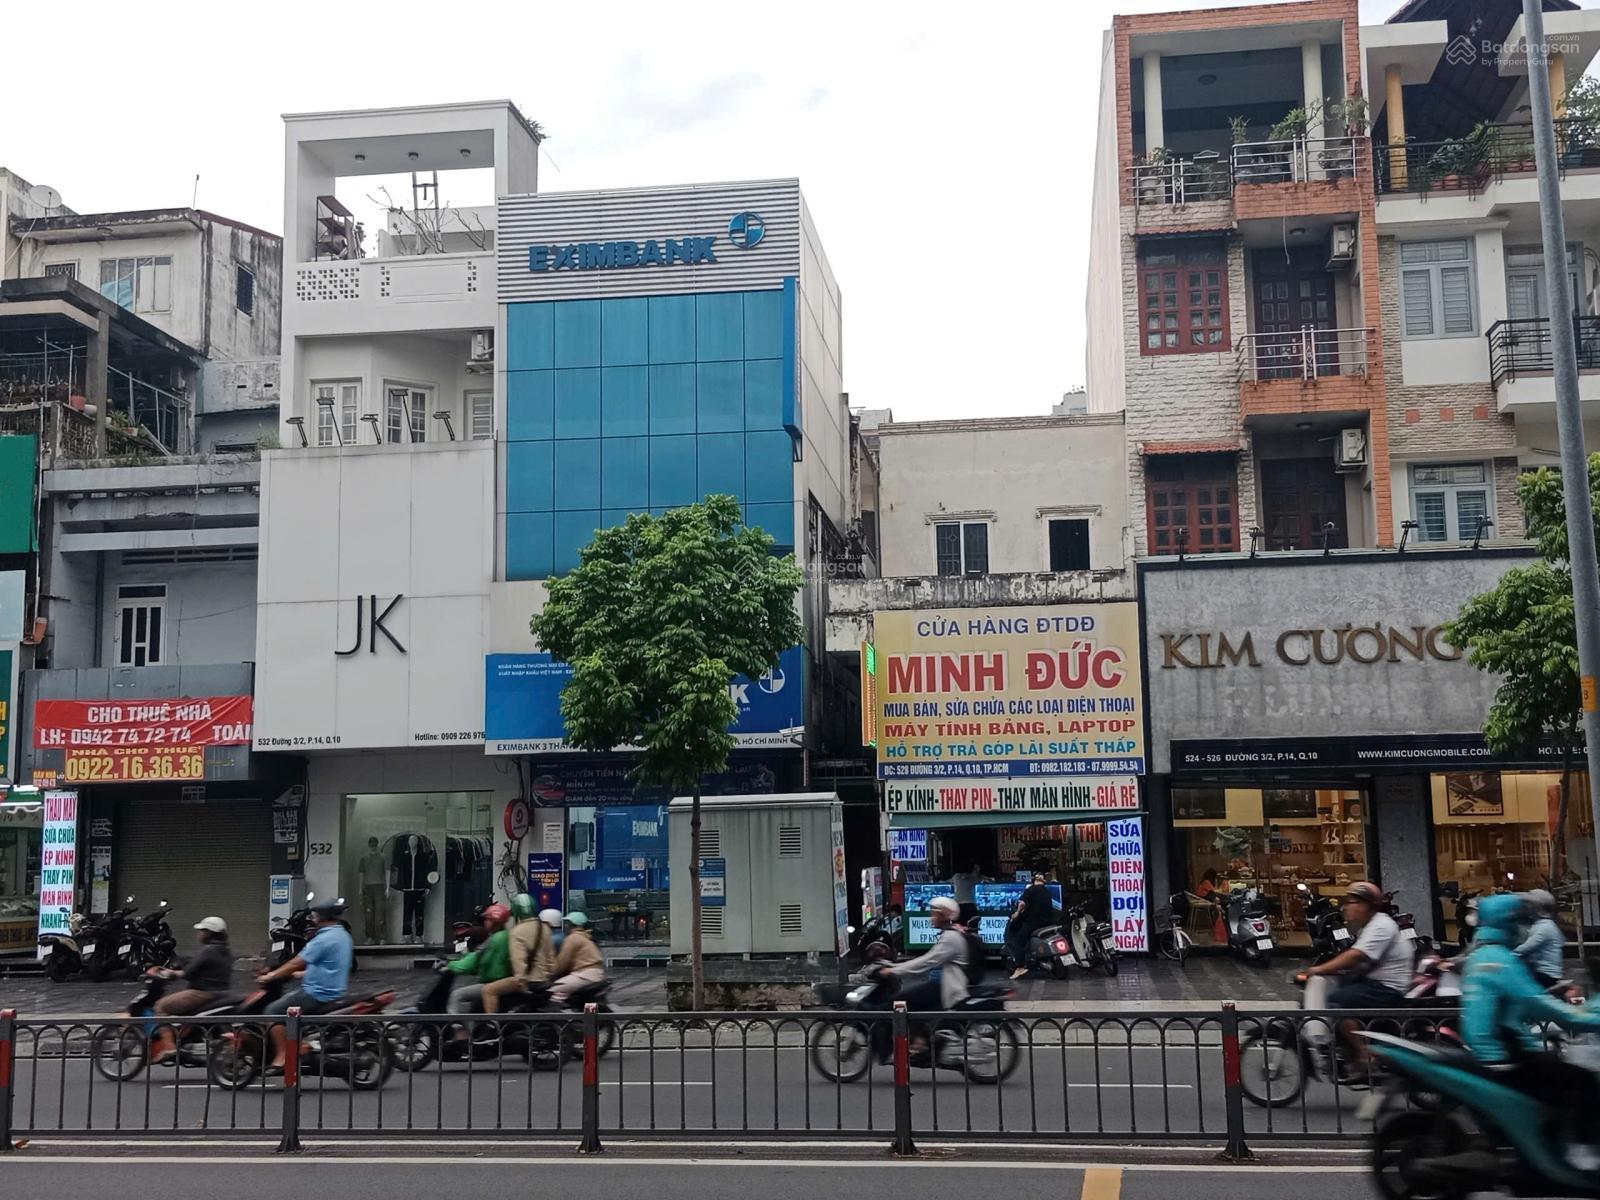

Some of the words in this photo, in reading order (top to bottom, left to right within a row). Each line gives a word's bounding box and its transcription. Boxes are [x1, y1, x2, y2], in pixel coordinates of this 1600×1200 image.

[528, 236, 718, 273] EXIMBANK
[334, 594, 407, 655] JK
[917, 614, 962, 638] CỬA
[968, 616, 1029, 636] HÀNG
[1036, 615, 1095, 633] ĐTDĐ
[1159, 630, 1260, 669] KIM
[887, 652, 1004, 694] MINH
[1025, 640, 1123, 692] ĐỨC
[87, 706, 122, 723] CHO
[127, 703, 171, 722] THUÊ
[176, 701, 212, 721] NHÀ
[884, 703, 910, 717] MUA
[913, 700, 942, 718] BÁN,
[945, 696, 969, 716] SỬA
[1009, 697, 1033, 714] CÁC
[1037, 698, 1063, 717] LOẠI
[1067, 695, 1095, 716] ĐIỆN
[1099, 697, 1135, 715] THOẠI
[40, 728, 66, 745] LH:
[70, 728, 113, 744] 0942
[117, 727, 139, 743] 74
[143, 727, 165, 743] 72
[169, 727, 191, 743] 74
[415, 732, 439, 741] Hotline:
[441, 732, 458, 740] 0909
[459, 731, 472, 740] 226
[884, 722, 928, 737] MÁY
[935, 721, 982, 736] TÍNH
[988, 718, 1051, 736] BẢNG,
[1058, 720, 1136, 734] LAPTOP
[258, 738, 270, 746] 532
[497, 743, 540, 751] EXIMBANK
[543, 743, 547, 751] 3
[742, 737, 753, 745] HỒ
[754, 737, 767, 745] CHÍ
[886, 740, 907, 757] HỖ
[912, 743, 943, 760] TRỢ
[947, 740, 977, 756] TRẢ
[983, 740, 1014, 756] GÓP
[1019, 739, 1043, 755] LÃI
[1048, 737, 1088, 755] SUẤT
[1094, 736, 1136, 753] THẤP
[1185, 754, 1199, 762] 524
[1206, 754, 1221, 762] 526
[1225, 752, 1259, 762] ĐƯỜNG
[1299, 752, 1318, 760] Q.10
[1358, 748, 1491, 759] WWW.KIMCUONGMOBILE.COM
[66, 755, 203, 780] 0922.16.36.36
[983, 763, 1009, 774] TP.HCM
[887, 785, 903, 811] ÉP
[1030, 782, 1058, 809] MÀN
[1120, 778, 1136, 807] RẺ
[1109, 819, 1141, 838] SỬA
[310, 843, 333, 855] 532
[910, 844, 926, 859] ZIN
[1110, 839, 1142, 856] CHỮA
[44, 849, 53, 865] ÉP
[55, 848, 74, 865] KÍNH
[1111, 858, 1142, 877] ĐIỆN
[43, 869, 60, 885] THAY
[61, 869, 73, 884] PIN
[1112, 878, 1144, 894] THOẠI
[1112, 896, 1144, 914] ĐỢI
[41, 912, 63, 929] NHANH
[1115, 935, 1146, 949] NGAY
